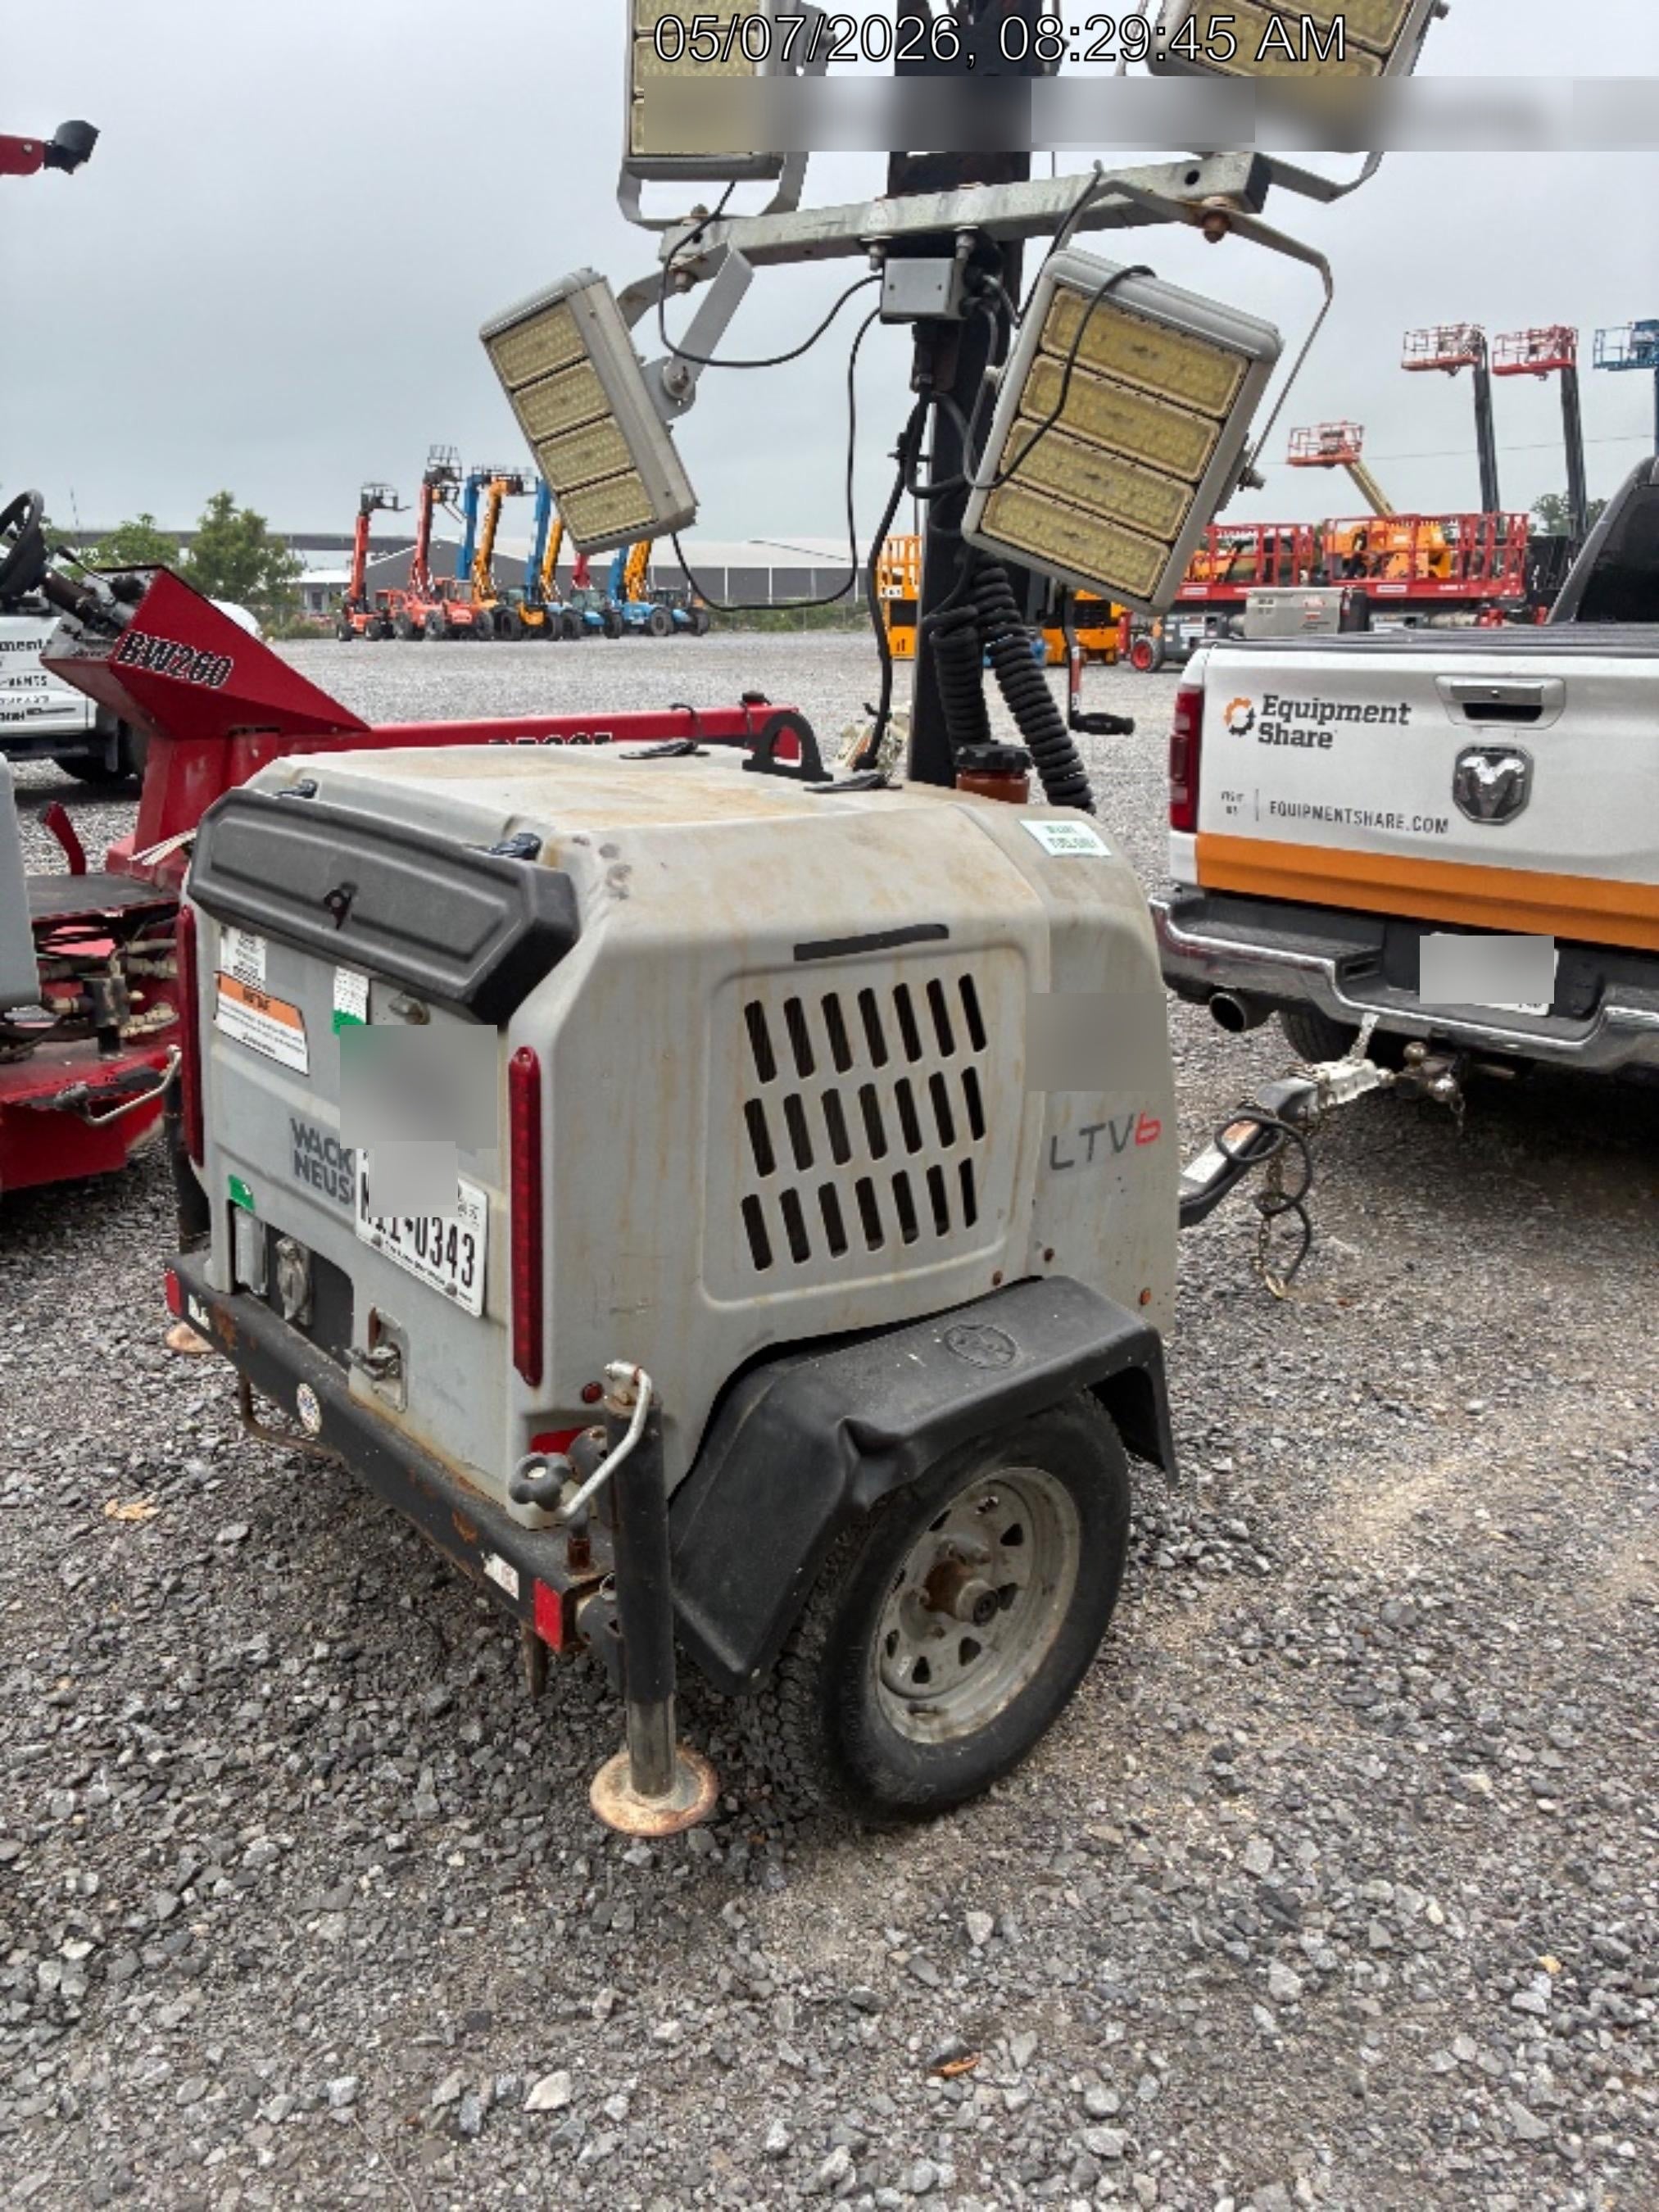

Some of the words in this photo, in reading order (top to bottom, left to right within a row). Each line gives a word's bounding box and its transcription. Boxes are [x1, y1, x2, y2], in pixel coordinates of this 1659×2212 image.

[1261, 693, 1412, 726] Equipment
[1258, 722, 1335, 750] Share
[1269, 800, 1449, 835] EQUIPMENTSHARE.COM
[294, 1149, 355, 1206] NEUS
